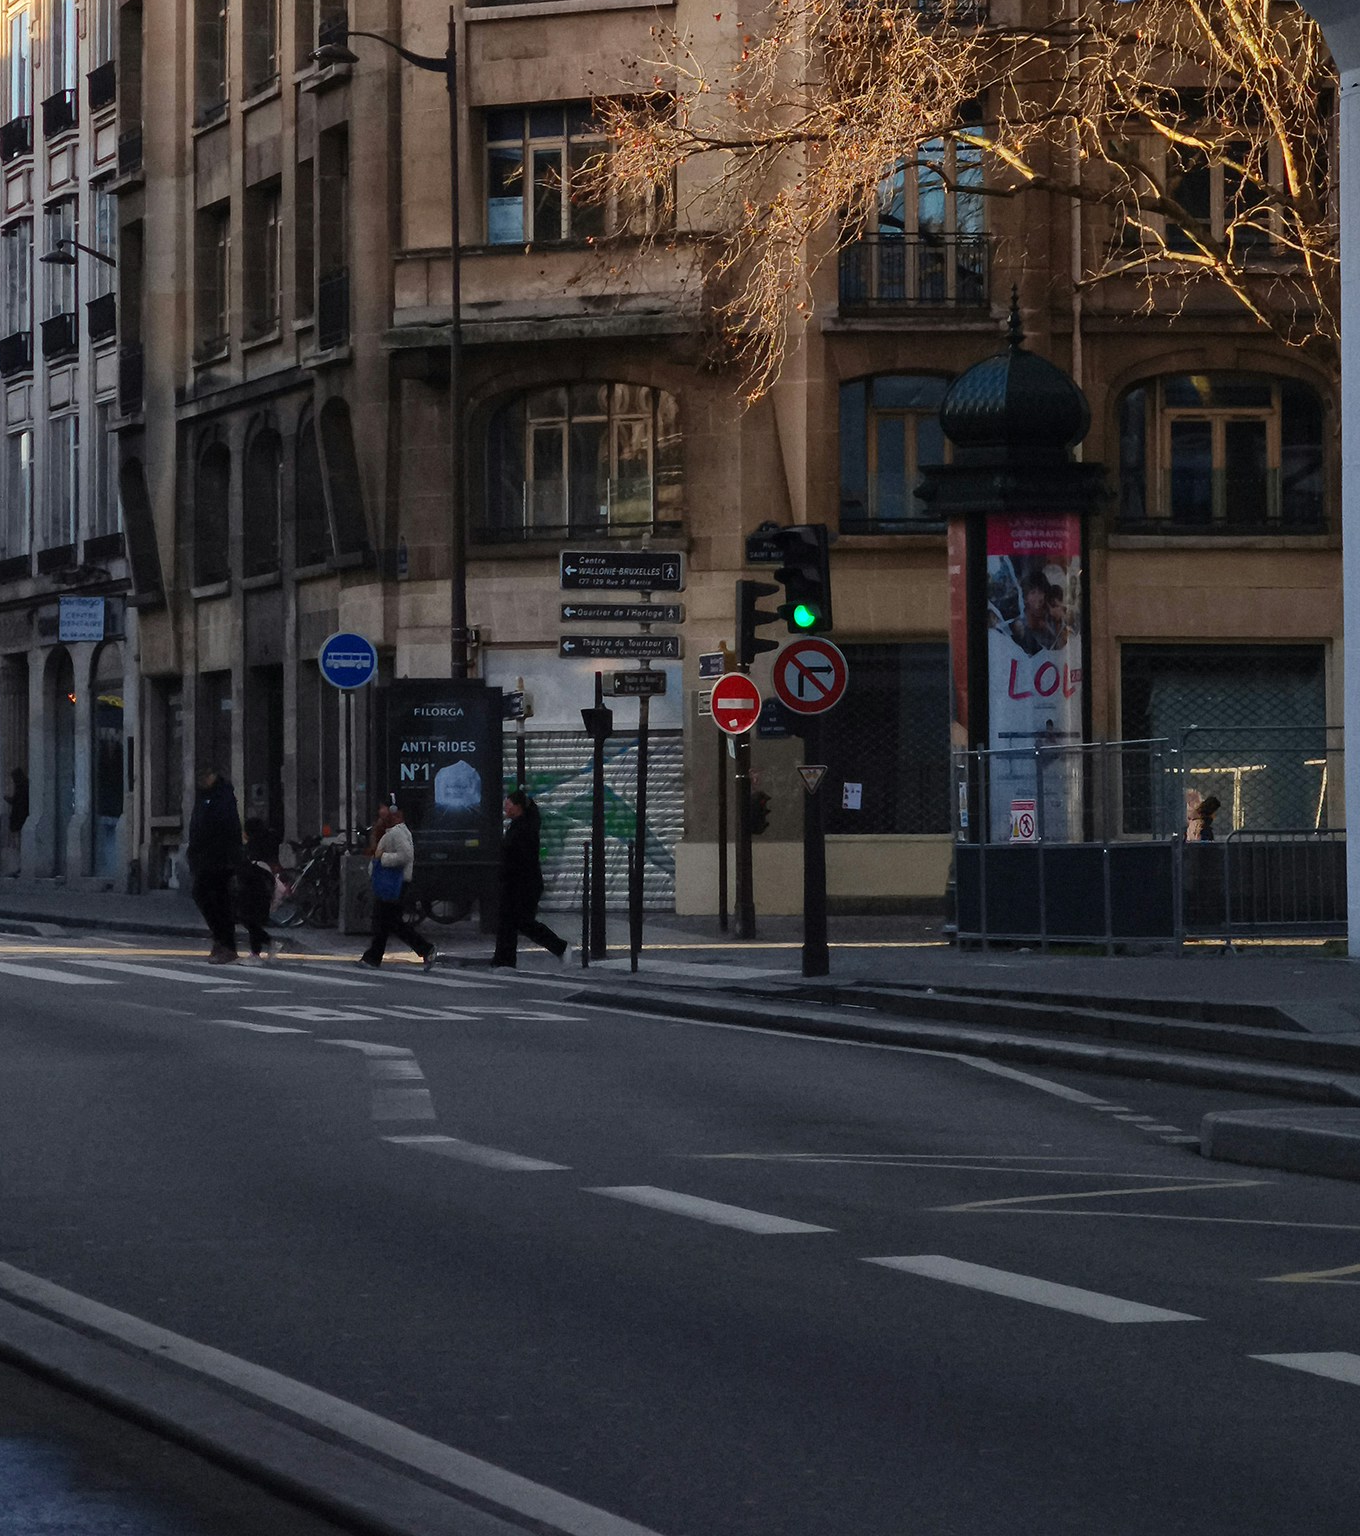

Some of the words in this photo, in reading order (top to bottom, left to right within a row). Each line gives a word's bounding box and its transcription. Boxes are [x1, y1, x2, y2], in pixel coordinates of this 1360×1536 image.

[578, 556, 606, 564] Centre
[578, 567, 661, 576] WALLONIE-BRUXELLES
[577, 608, 611, 617] Quartier
[613, 608, 624, 617] de
[614, 638, 625, 647] du
[1008, 659, 1077, 700] LOL
[413, 707, 465, 717] FILORGA
[400, 741, 477, 753] ANTI-RIDES
